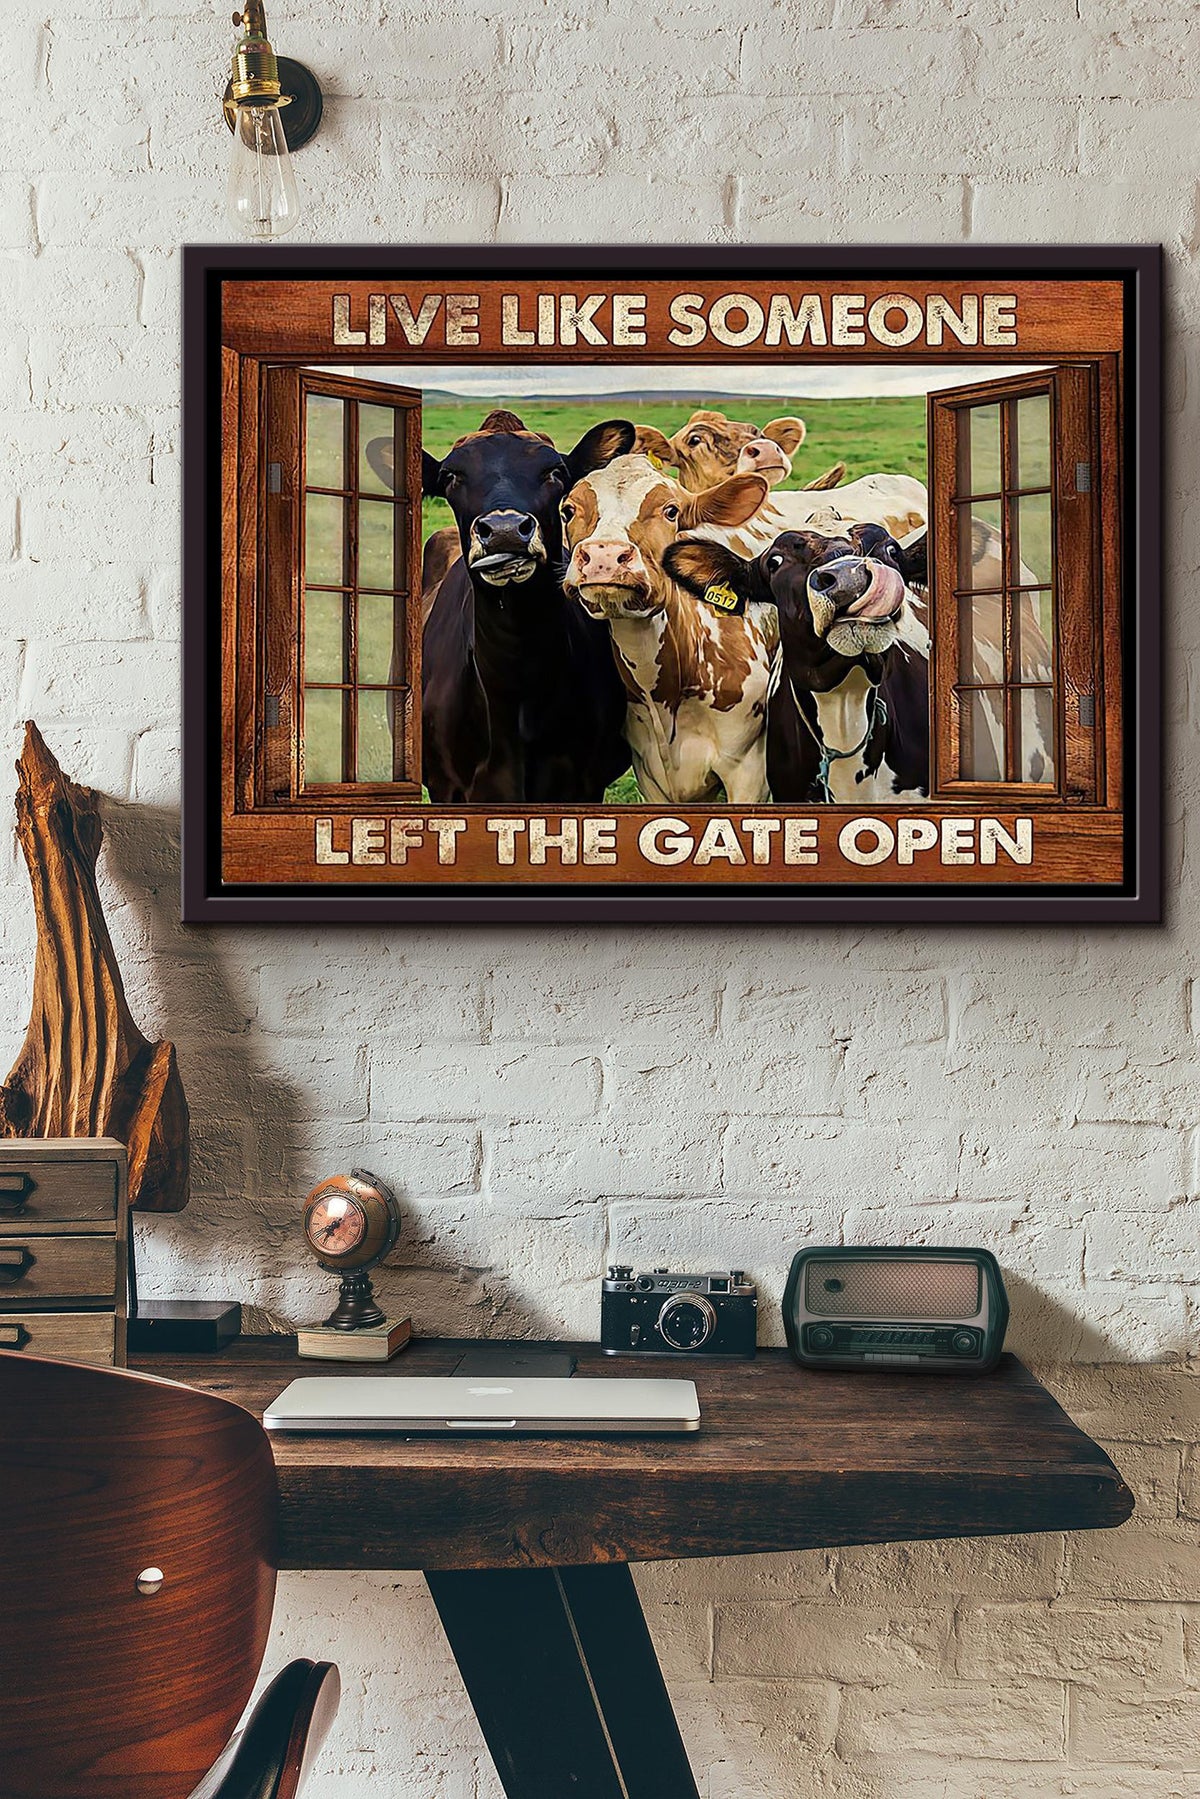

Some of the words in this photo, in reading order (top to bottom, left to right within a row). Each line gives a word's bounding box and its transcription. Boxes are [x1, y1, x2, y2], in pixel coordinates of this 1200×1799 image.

[331, 293, 480, 346] LIVE
[502, 293, 647, 346] LIKE
[667, 293, 1019, 347] SOMEONE
[706, 591, 735, 608] 0517
[313, 814, 467, 865] LEFT
[487, 814, 617, 865] THE
[638, 814, 818, 866] GATE
[838, 814, 1033, 866] OPEN
